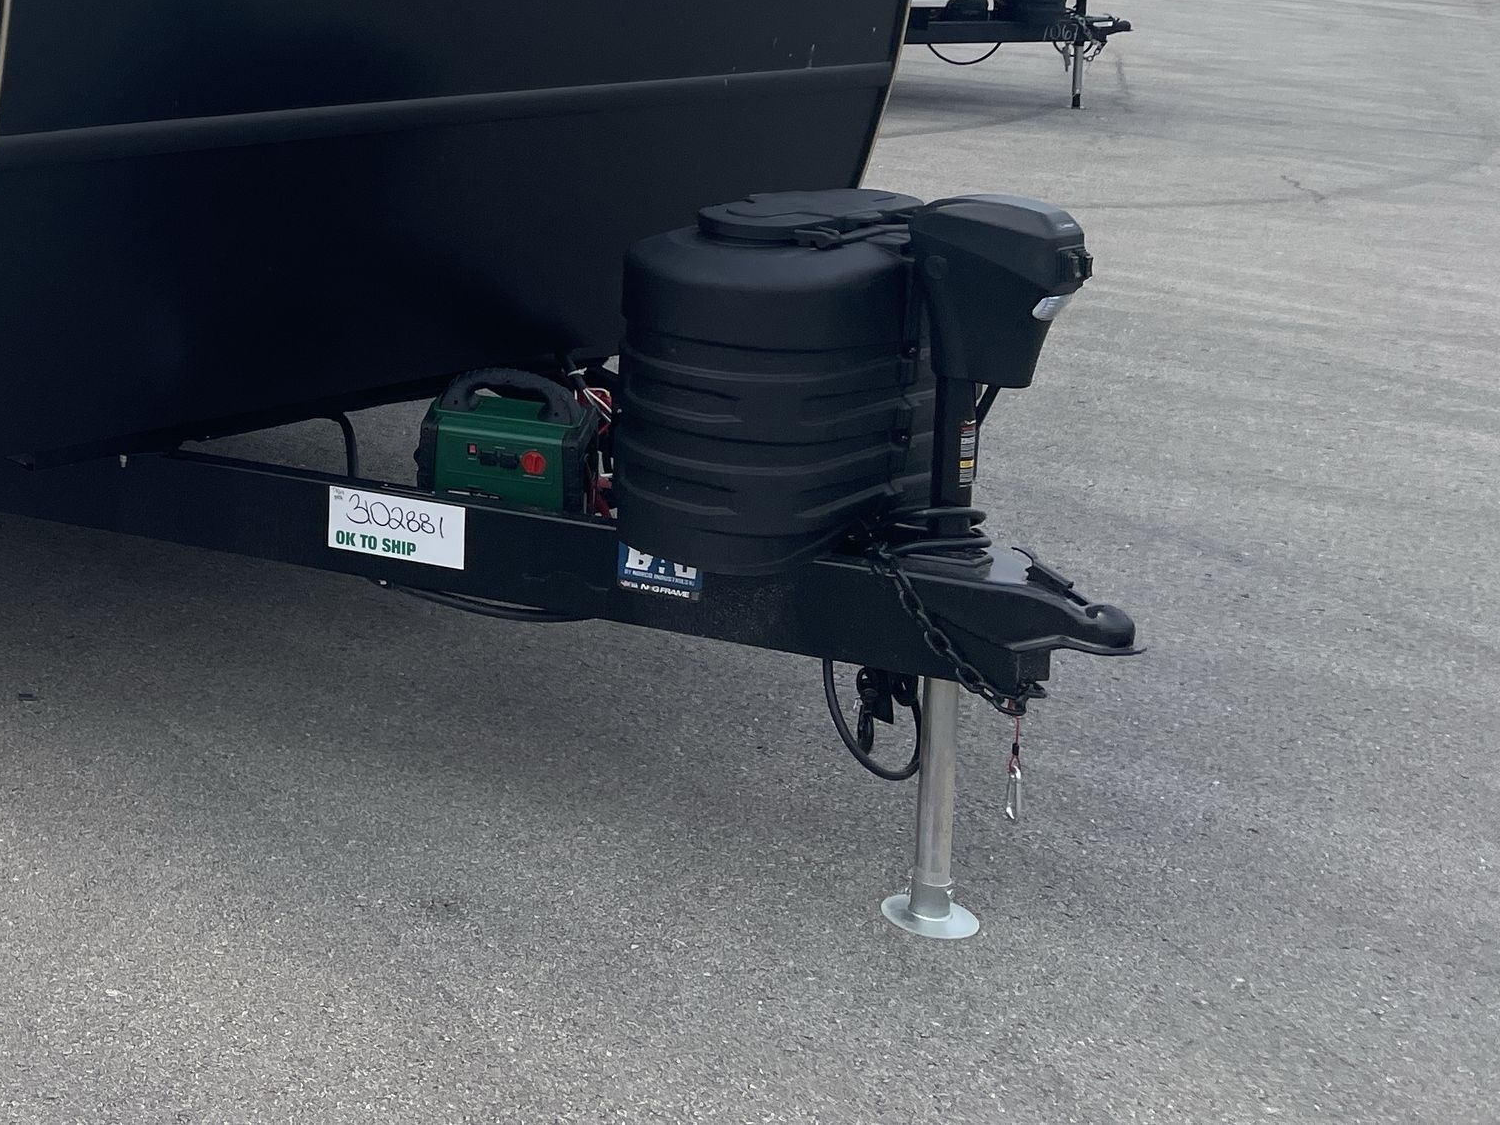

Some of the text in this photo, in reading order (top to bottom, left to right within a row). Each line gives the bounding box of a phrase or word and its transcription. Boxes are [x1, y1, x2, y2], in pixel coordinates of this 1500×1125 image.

[335, 530, 417, 556] OK TO SHIP
[640, 583, 660, 593] NG
[661, 588, 689, 598] FRAME
